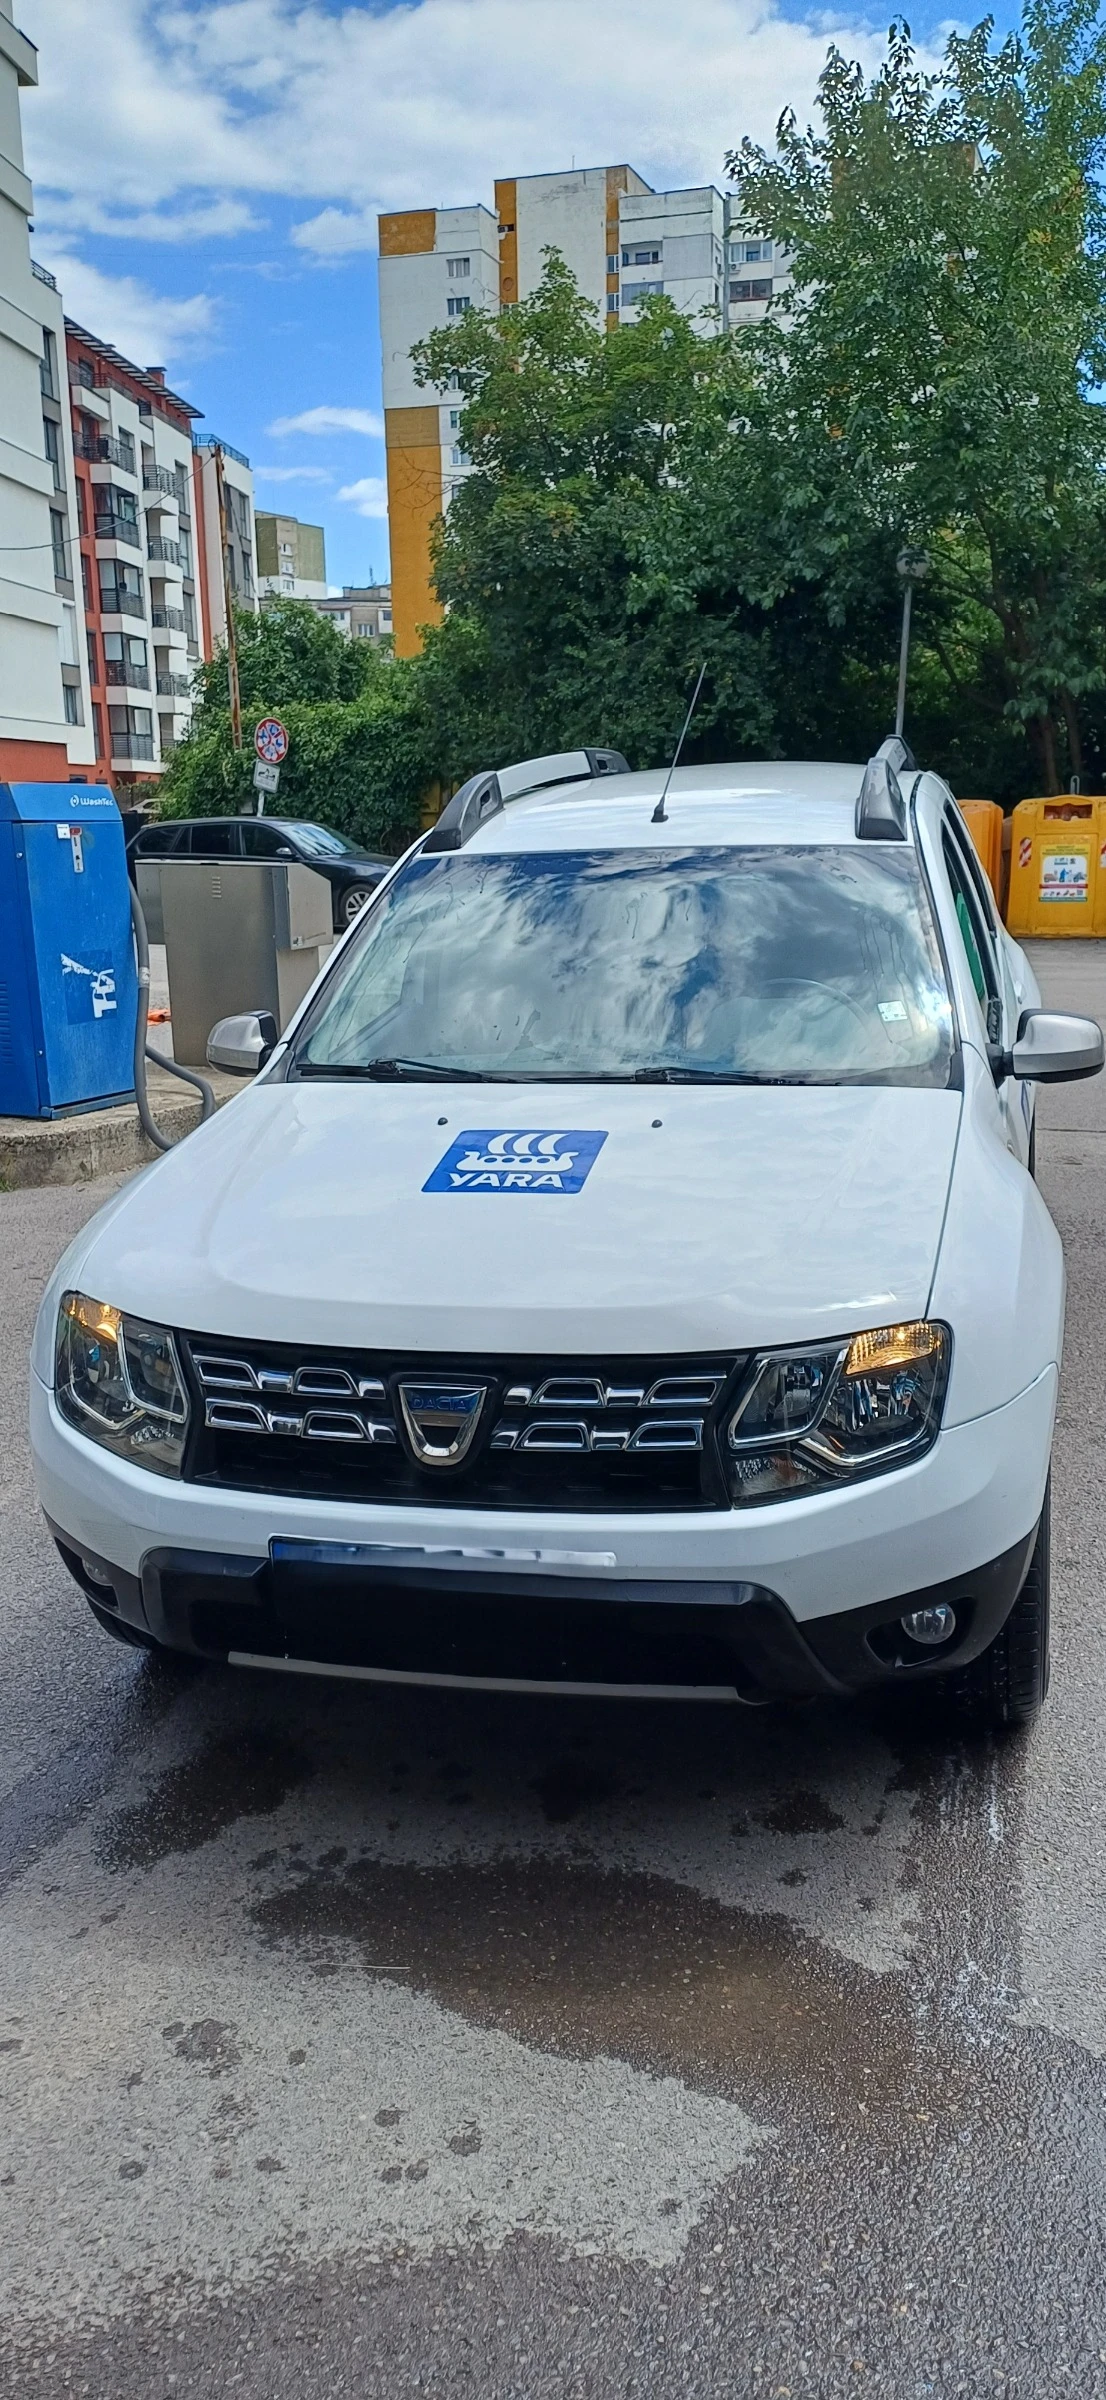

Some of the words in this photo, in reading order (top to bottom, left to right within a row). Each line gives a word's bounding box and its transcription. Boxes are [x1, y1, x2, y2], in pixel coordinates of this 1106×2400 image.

[80, 797, 114, 806] WashTec
[449, 1173, 564, 1188] YARA
[412, 1398, 467, 1410] DACIA
